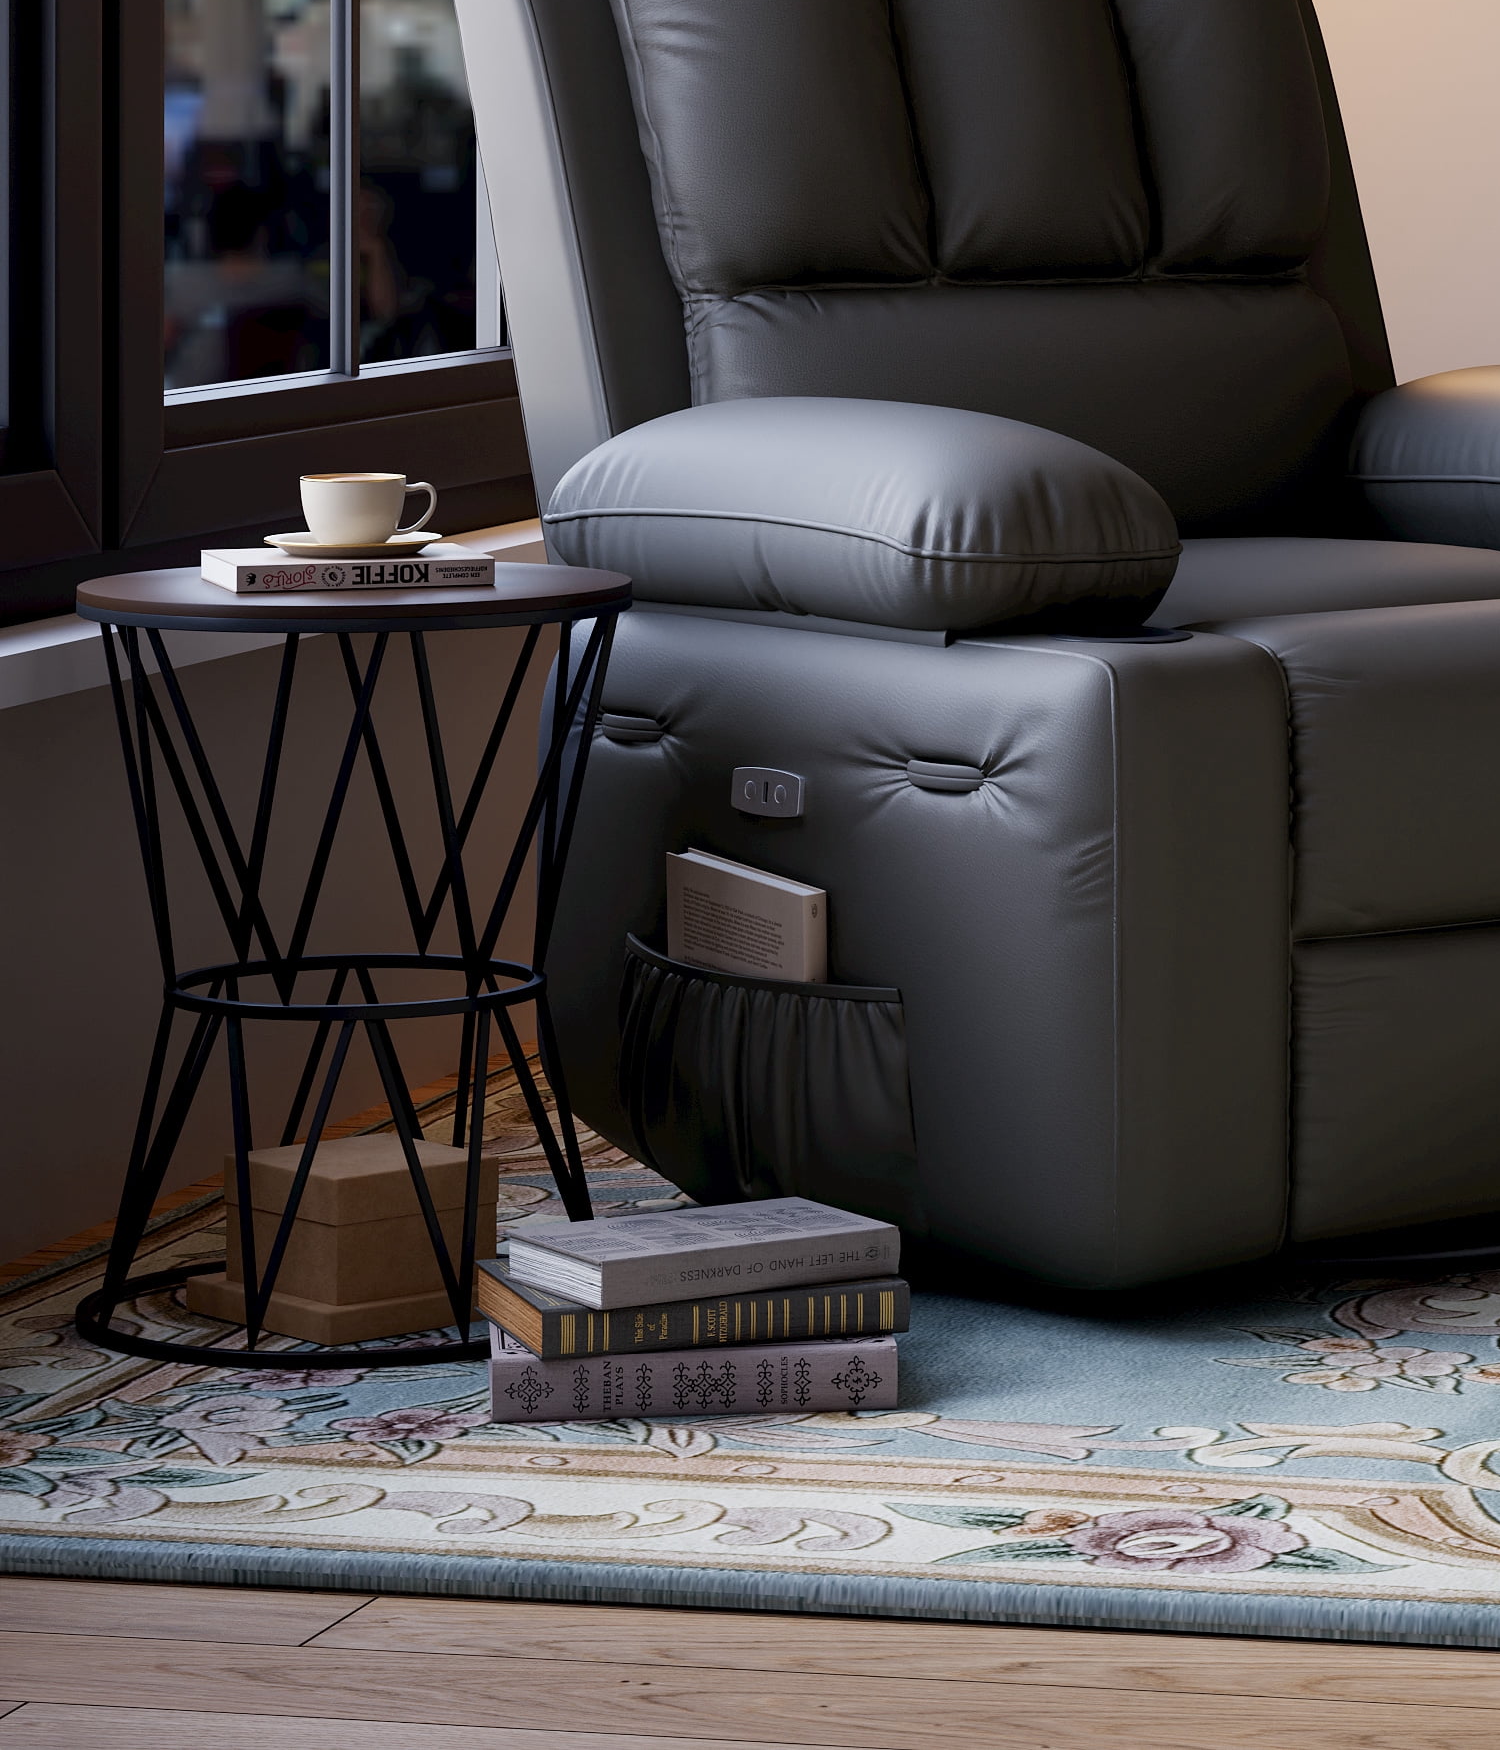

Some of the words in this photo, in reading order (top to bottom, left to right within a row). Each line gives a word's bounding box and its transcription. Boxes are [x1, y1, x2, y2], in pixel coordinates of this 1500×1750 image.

[351, 563, 430, 586] KOFFIE
[769, 1256, 806, 1271] HAND
[808, 1253, 836, 1267] LEFT
[838, 1250, 861, 1263] THE
[679, 1264, 742, 1282] DARKNESS
[746, 1261, 765, 1274] OF
[634, 1313, 644, 1328] Side
[658, 1312, 668, 1340] Paradise
[707, 1308, 716, 1331] SCOTT
[718, 1301, 728, 1343] FITZGERALD
[634, 1328, 644, 1344] This
[602, 1361, 612, 1413] THEBAN
[614, 1366, 624, 1406] PLAYS
[780, 1356, 789, 1405] SOPHOCLES
